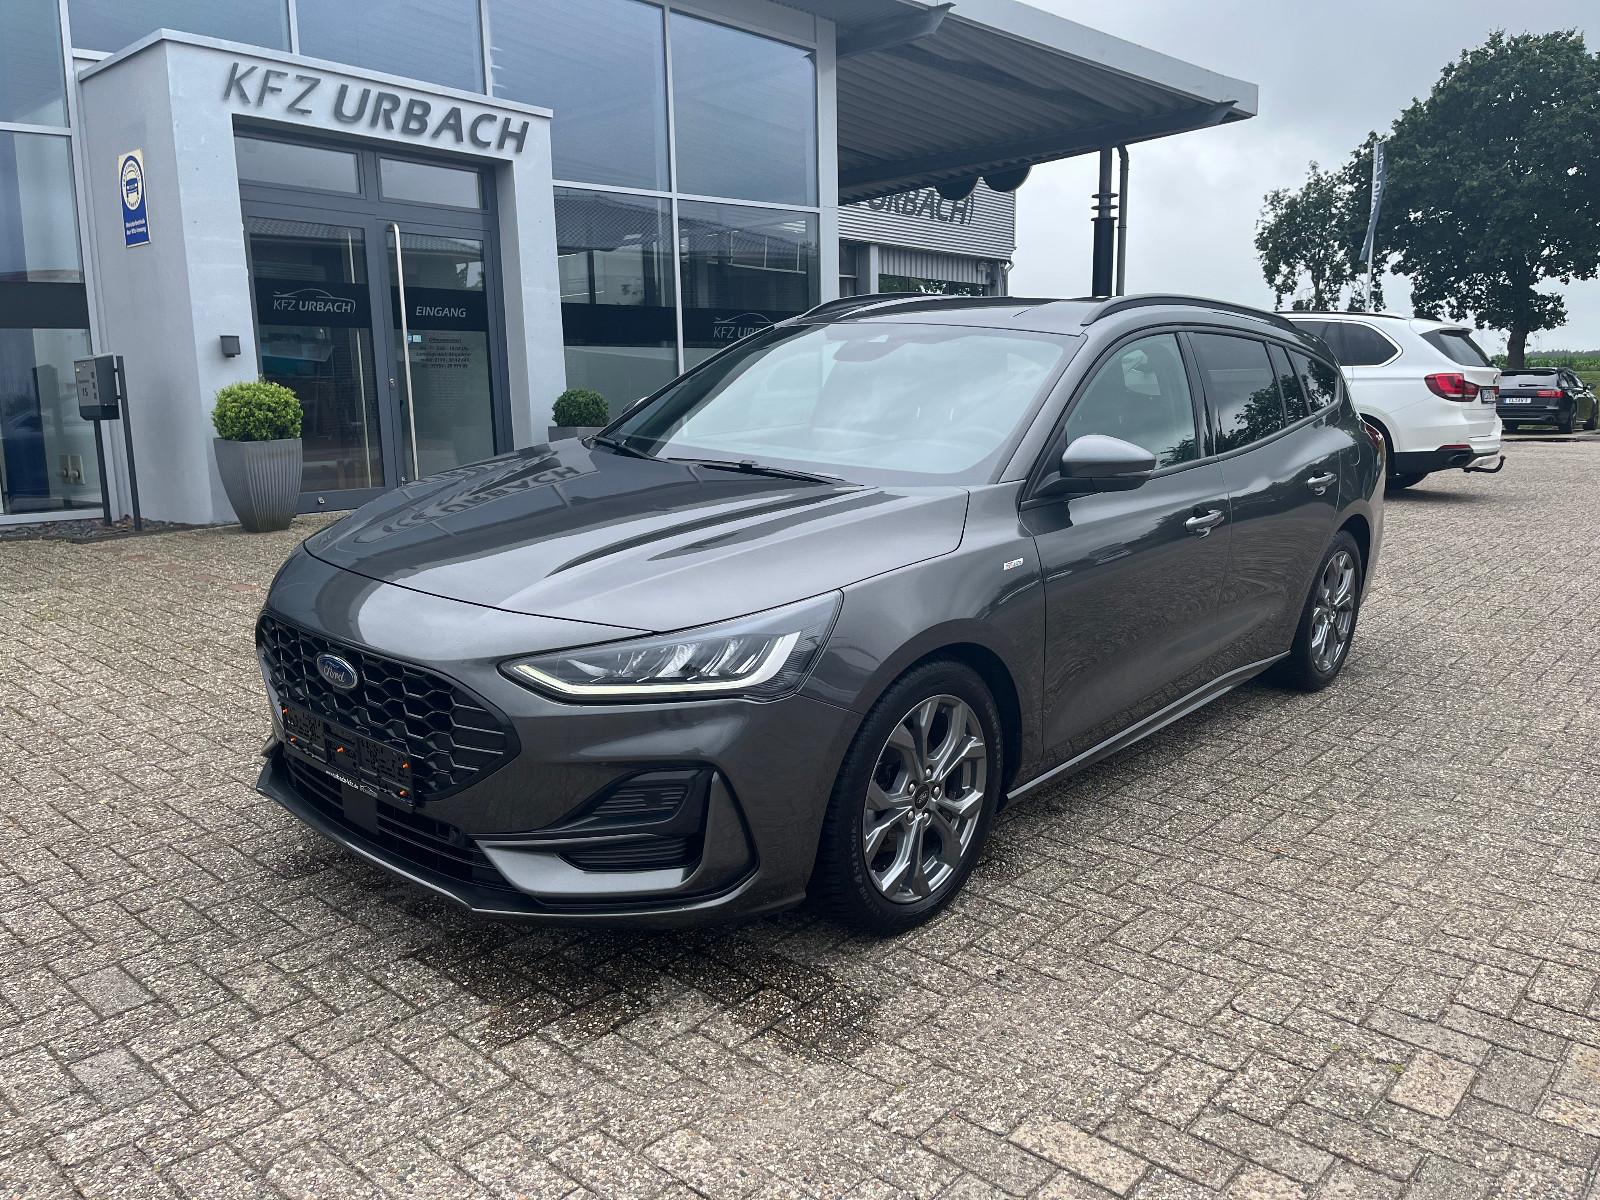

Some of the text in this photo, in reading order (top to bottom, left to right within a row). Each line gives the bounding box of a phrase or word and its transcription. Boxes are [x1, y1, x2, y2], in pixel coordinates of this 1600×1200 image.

[223, 62, 530, 153] KFZ URBACH
[273, 299, 352, 313] KFZ URBACH
[415, 306, 467, 318] EINGANG
[713, 326, 736, 339] KFZ
[323, 664, 345, 683] Ford
